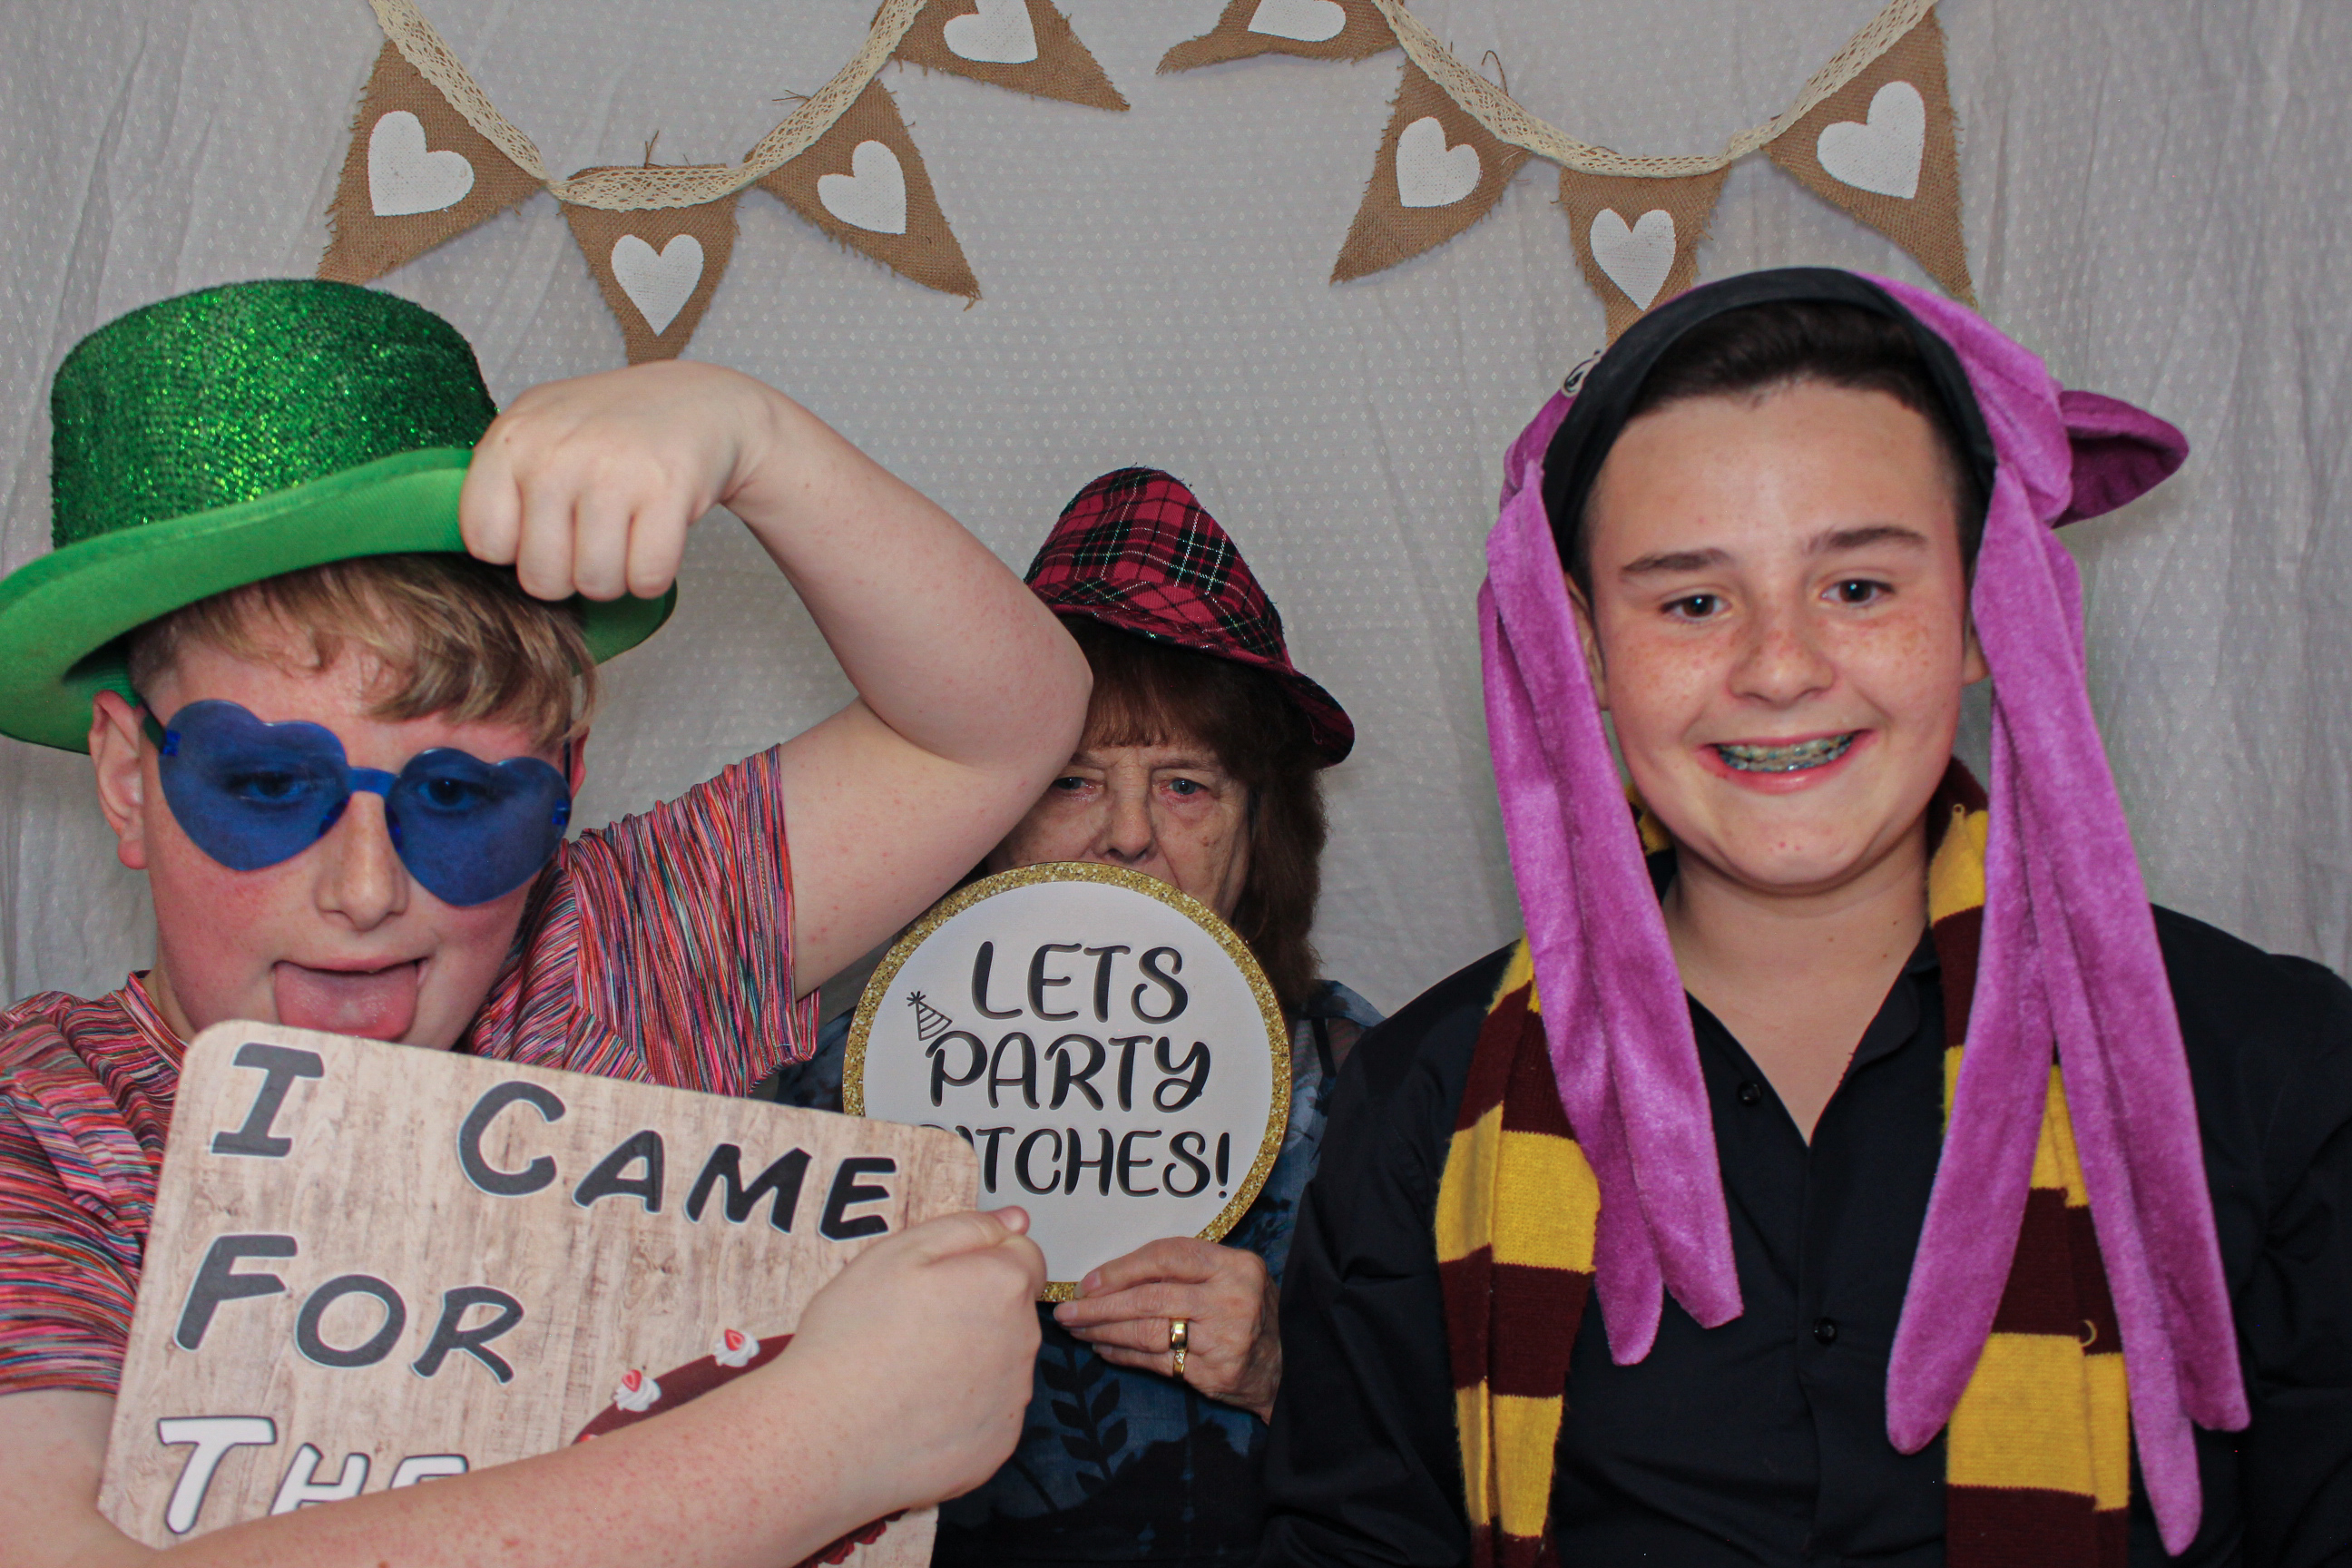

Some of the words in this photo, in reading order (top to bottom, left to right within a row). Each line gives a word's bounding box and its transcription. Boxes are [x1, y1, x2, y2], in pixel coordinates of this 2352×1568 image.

[970, 940, 1188, 1024] LETS
[925, 1030, 1211, 1113] PARTY
[209, 1041, 325, 1158] I
[456, 1079, 898, 1242] CAME
[918, 1123, 1230, 1199] TCHES!
[172, 1234, 526, 1386] FOR
